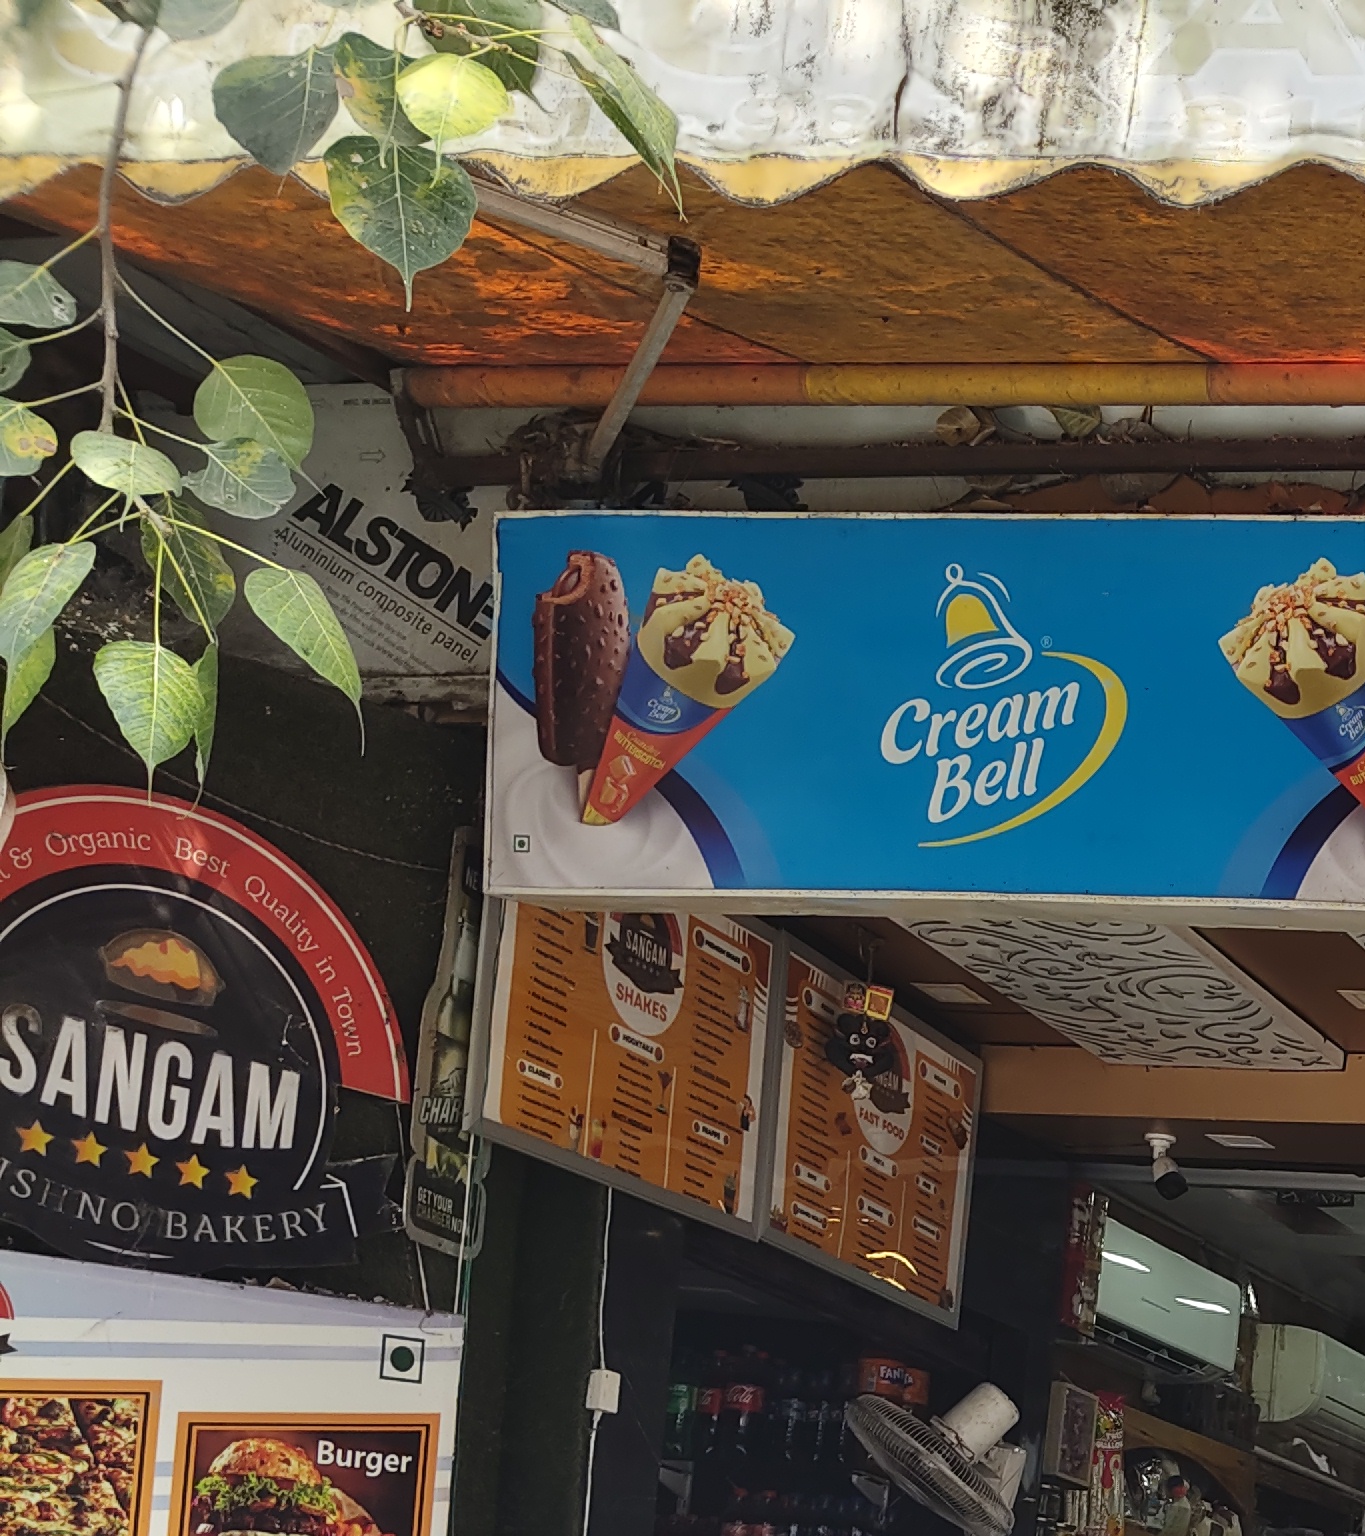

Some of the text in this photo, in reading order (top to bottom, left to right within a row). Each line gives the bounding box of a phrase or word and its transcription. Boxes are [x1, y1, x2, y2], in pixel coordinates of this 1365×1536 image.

[278, 527, 355, 585] Aluminium
[355, 578, 433, 635] composite
[431, 629, 479, 664] panel
[880, 681, 1081, 765] Cream
[926, 738, 1045, 824] Bell
[44, 828, 152, 858] Organic
[174, 837, 231, 879] Best
[243, 875, 319, 955] Quality
[314, 957, 338, 986] in
[331, 986, 362, 1058] Town
[625, 929, 668, 967] SANGAM
[616, 982, 668, 1023] SHAKES
[0, 1003, 302, 1151] SANGAM
[859, 1106, 905, 1141] FAST FOOD
[164, 1203, 329, 1246] BAKERY
[316, 1440, 413, 1477] Burger
